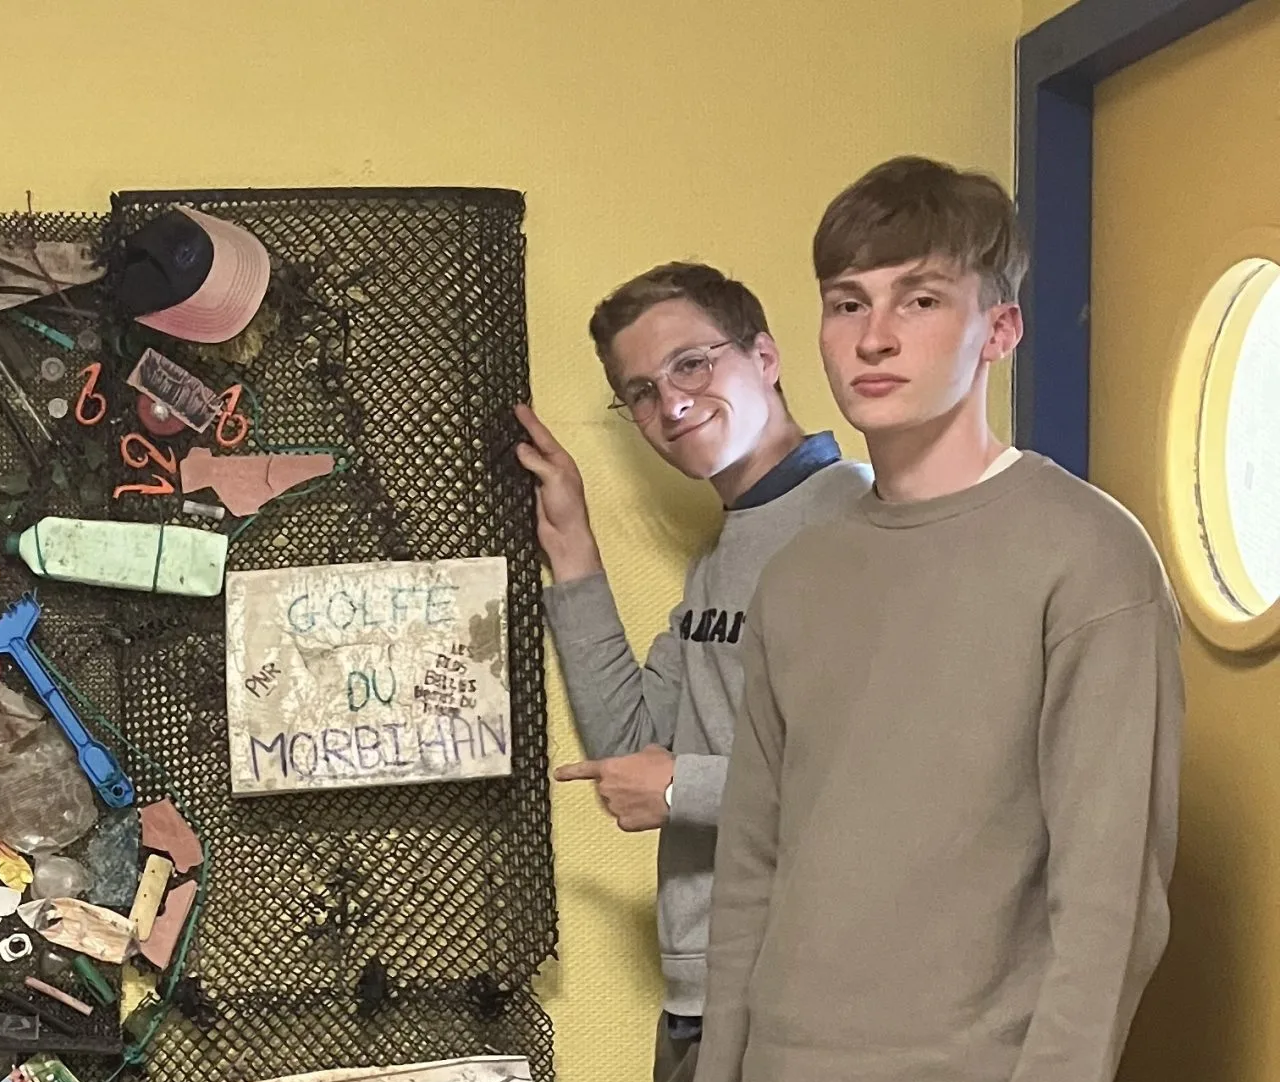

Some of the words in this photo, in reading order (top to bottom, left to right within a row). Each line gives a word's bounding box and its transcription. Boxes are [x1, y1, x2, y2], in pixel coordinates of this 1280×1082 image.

[287, 586, 460, 632] GOLFE
[245, 662, 282, 698] PNR
[348, 668, 397, 712] DU
[249, 713, 507, 783] MORBIHAN
